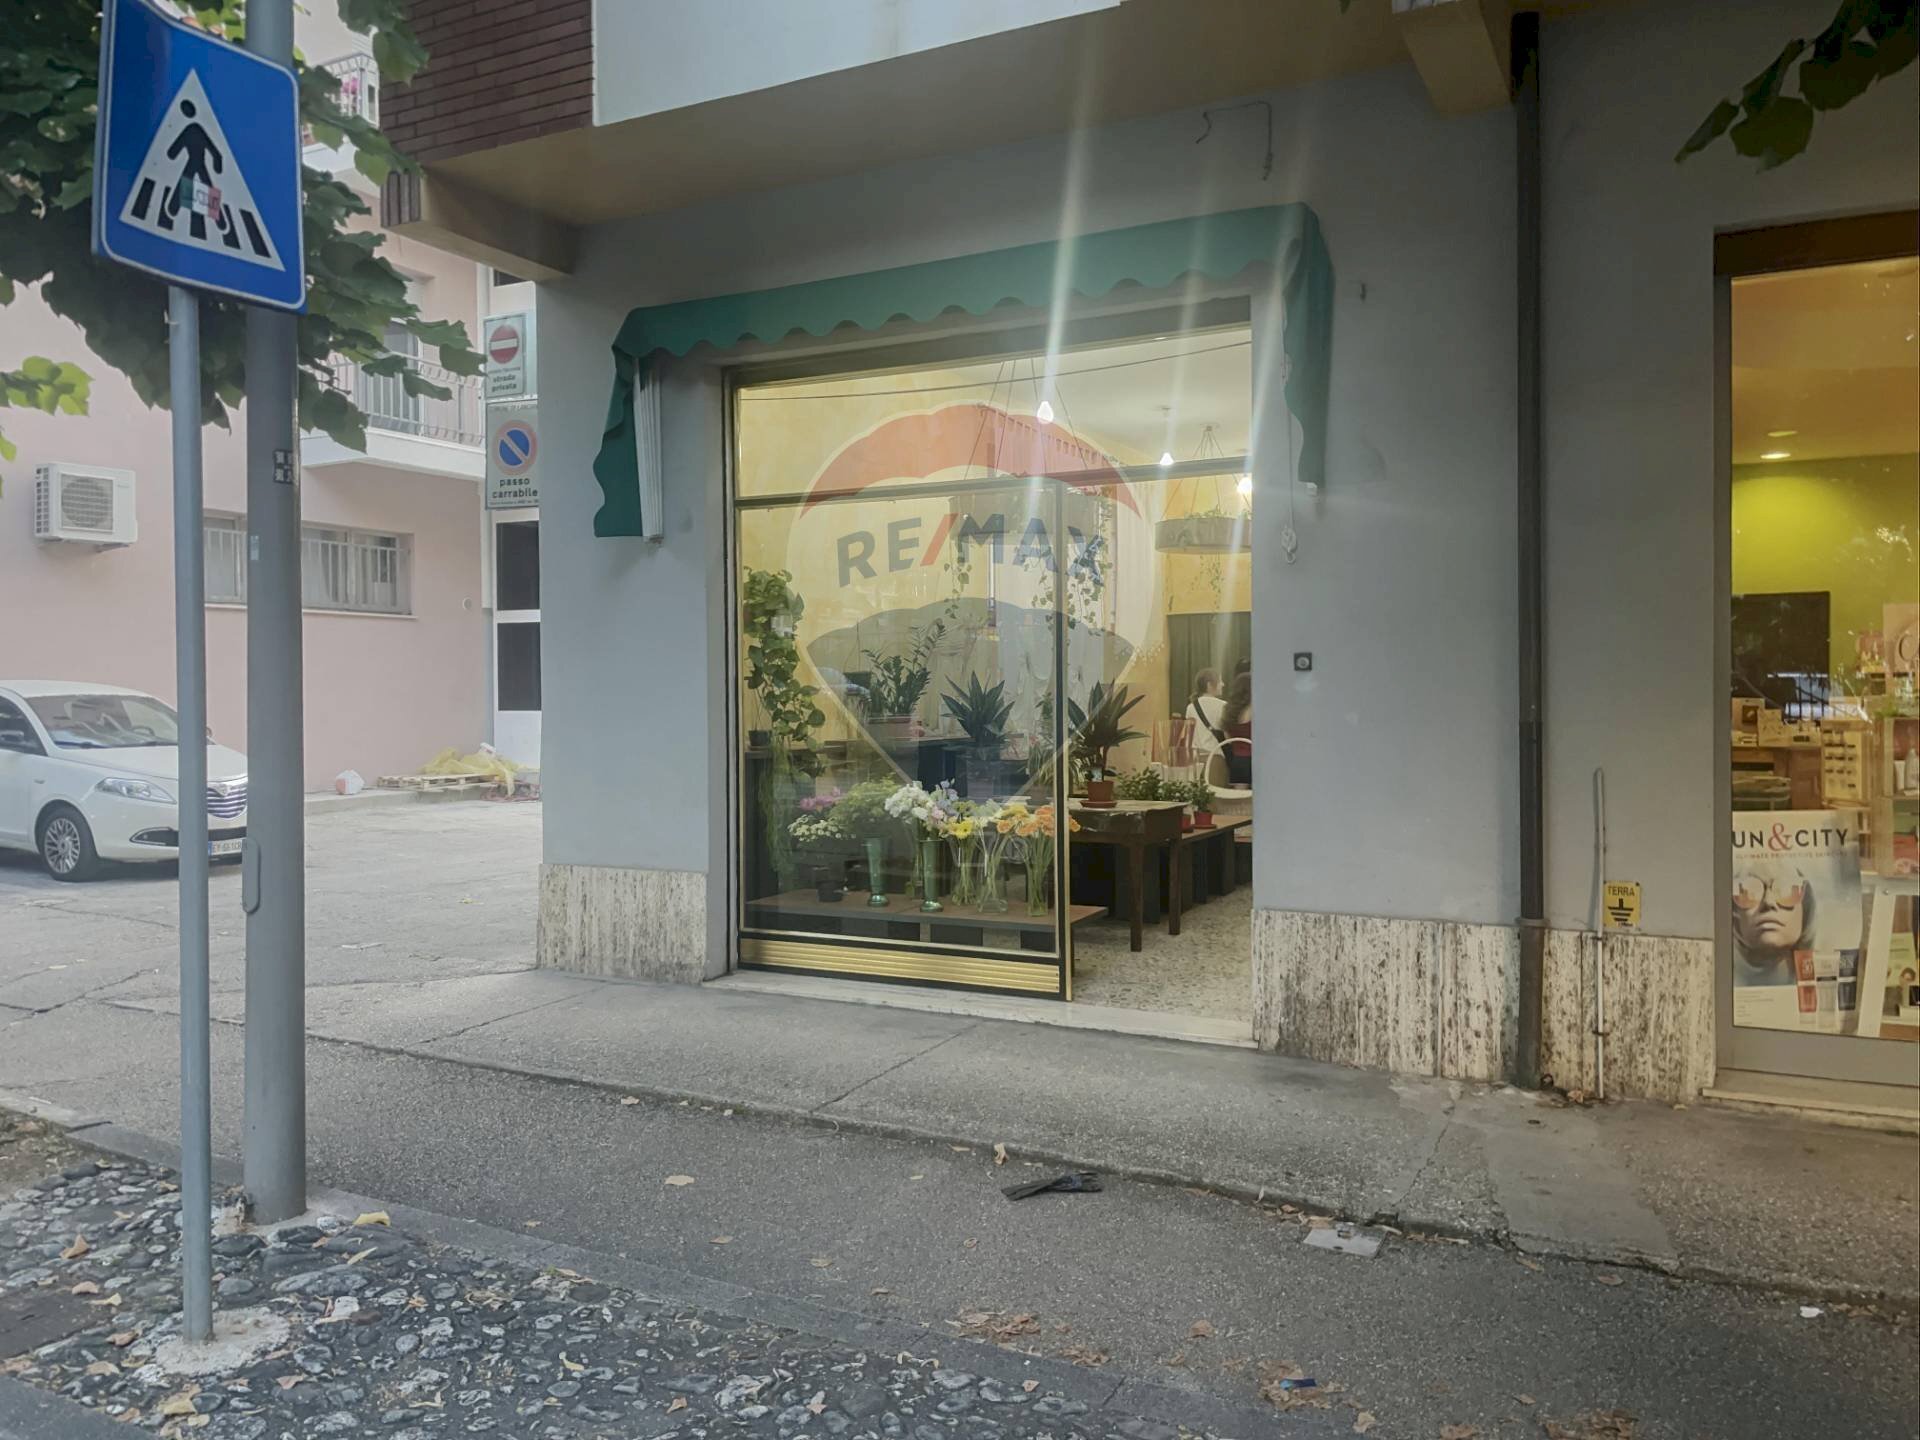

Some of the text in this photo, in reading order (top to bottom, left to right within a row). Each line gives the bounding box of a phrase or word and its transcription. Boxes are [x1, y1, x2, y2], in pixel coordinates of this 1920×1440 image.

[493, 374, 516, 382] strada
[492, 383, 517, 392] privata
[499, 478, 530, 488] passo
[492, 488, 538, 499] carrabile
[1607, 885, 1635, 896] TERRA
